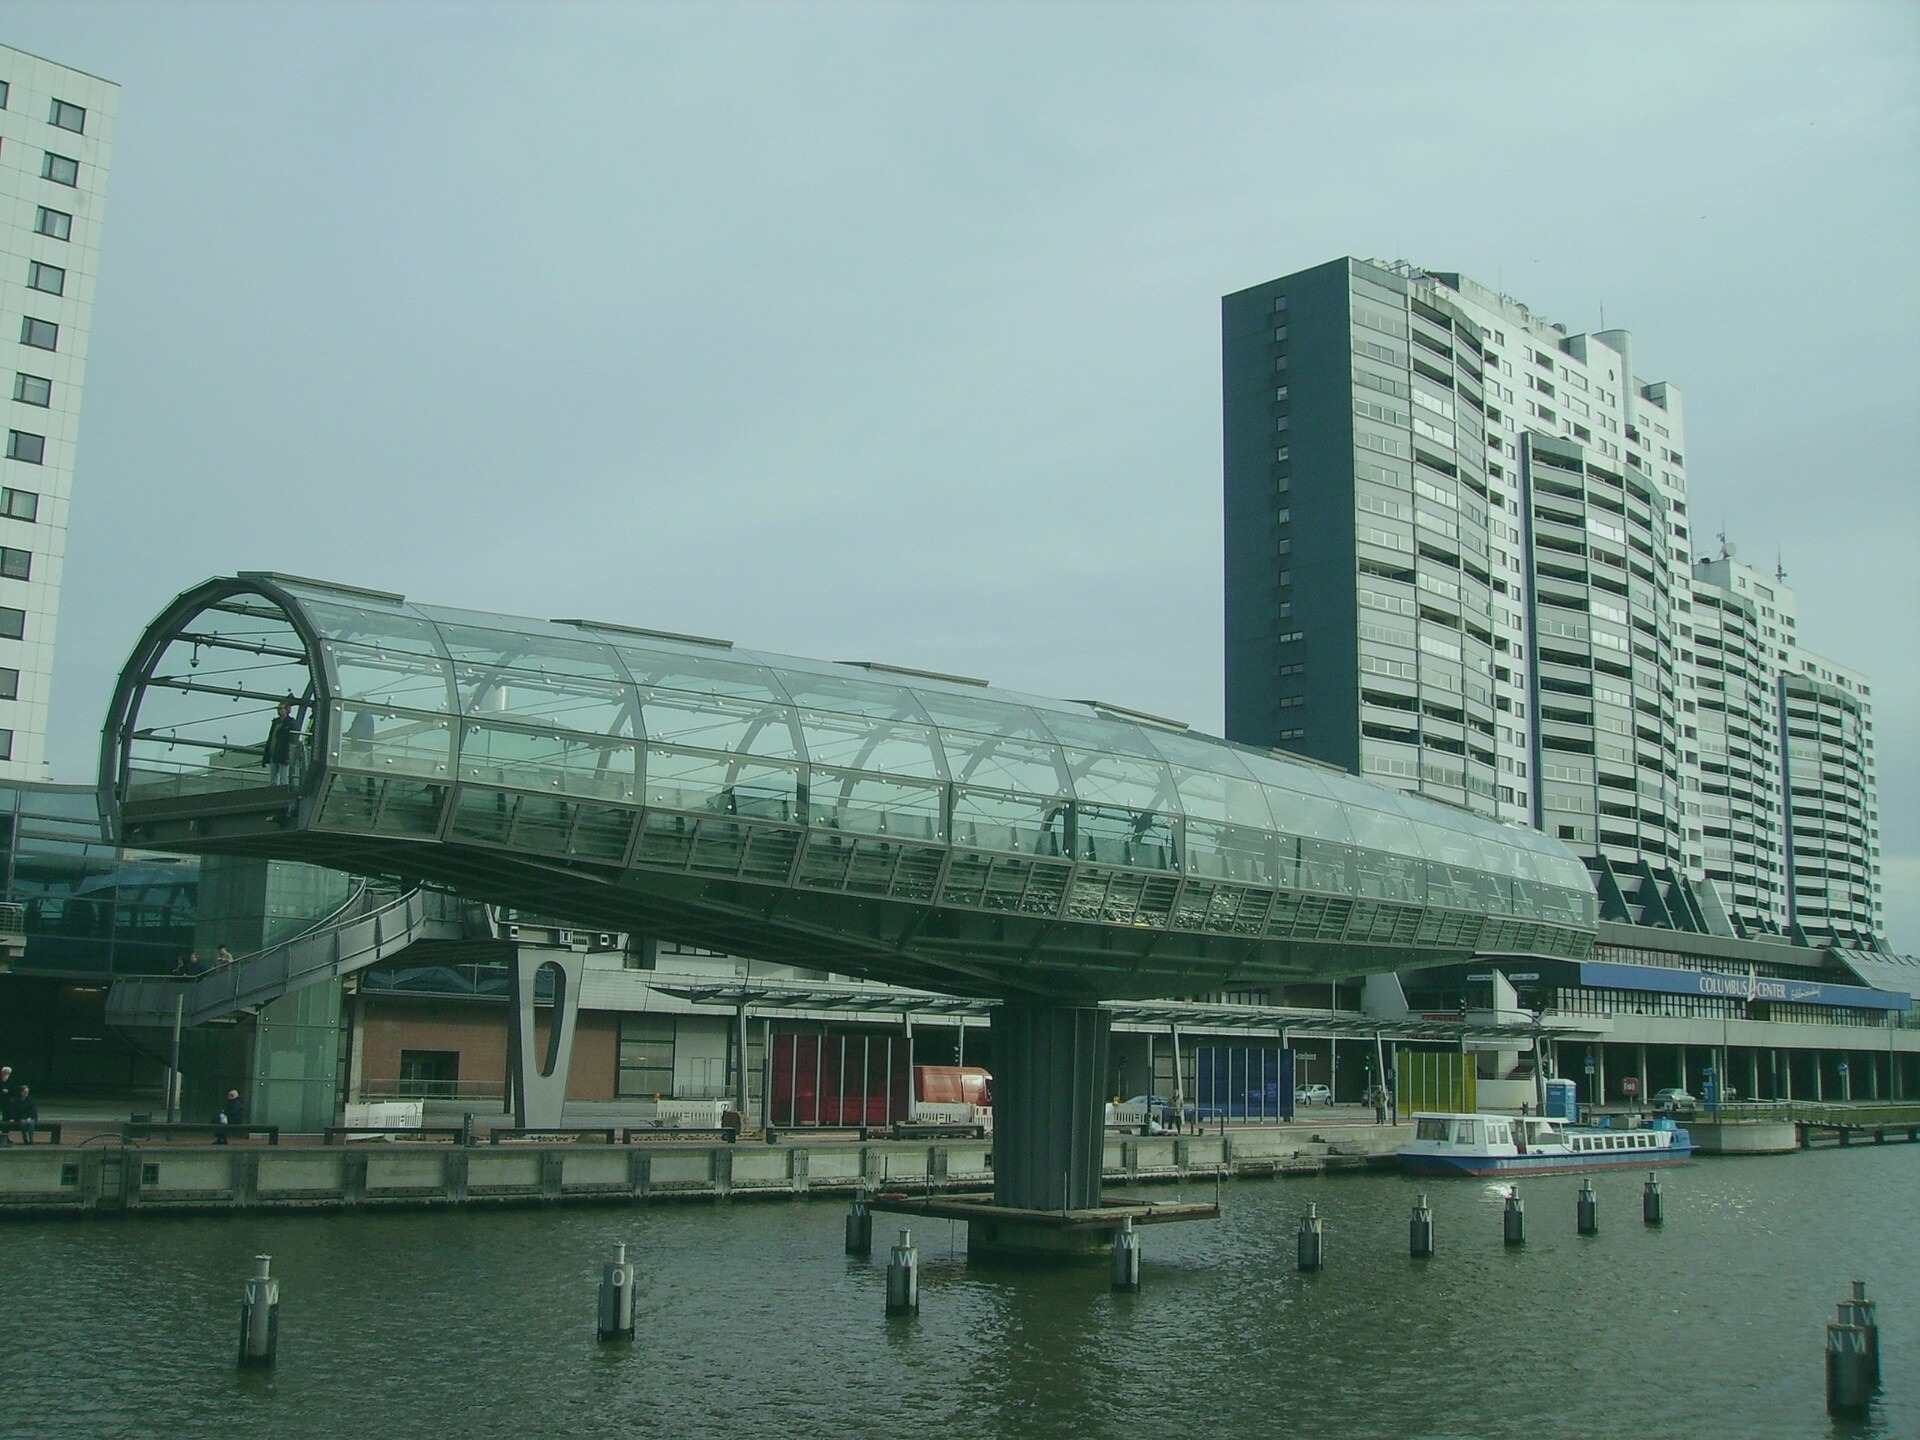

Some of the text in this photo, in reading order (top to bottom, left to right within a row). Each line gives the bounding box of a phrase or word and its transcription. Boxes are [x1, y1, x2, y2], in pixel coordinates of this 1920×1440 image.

[1699, 977, 1749, 996] COLUMBUS
[1757, 982, 1786, 998] CENTER
[1120, 1234, 1137, 1249] W
[898, 1250, 917, 1267] W
